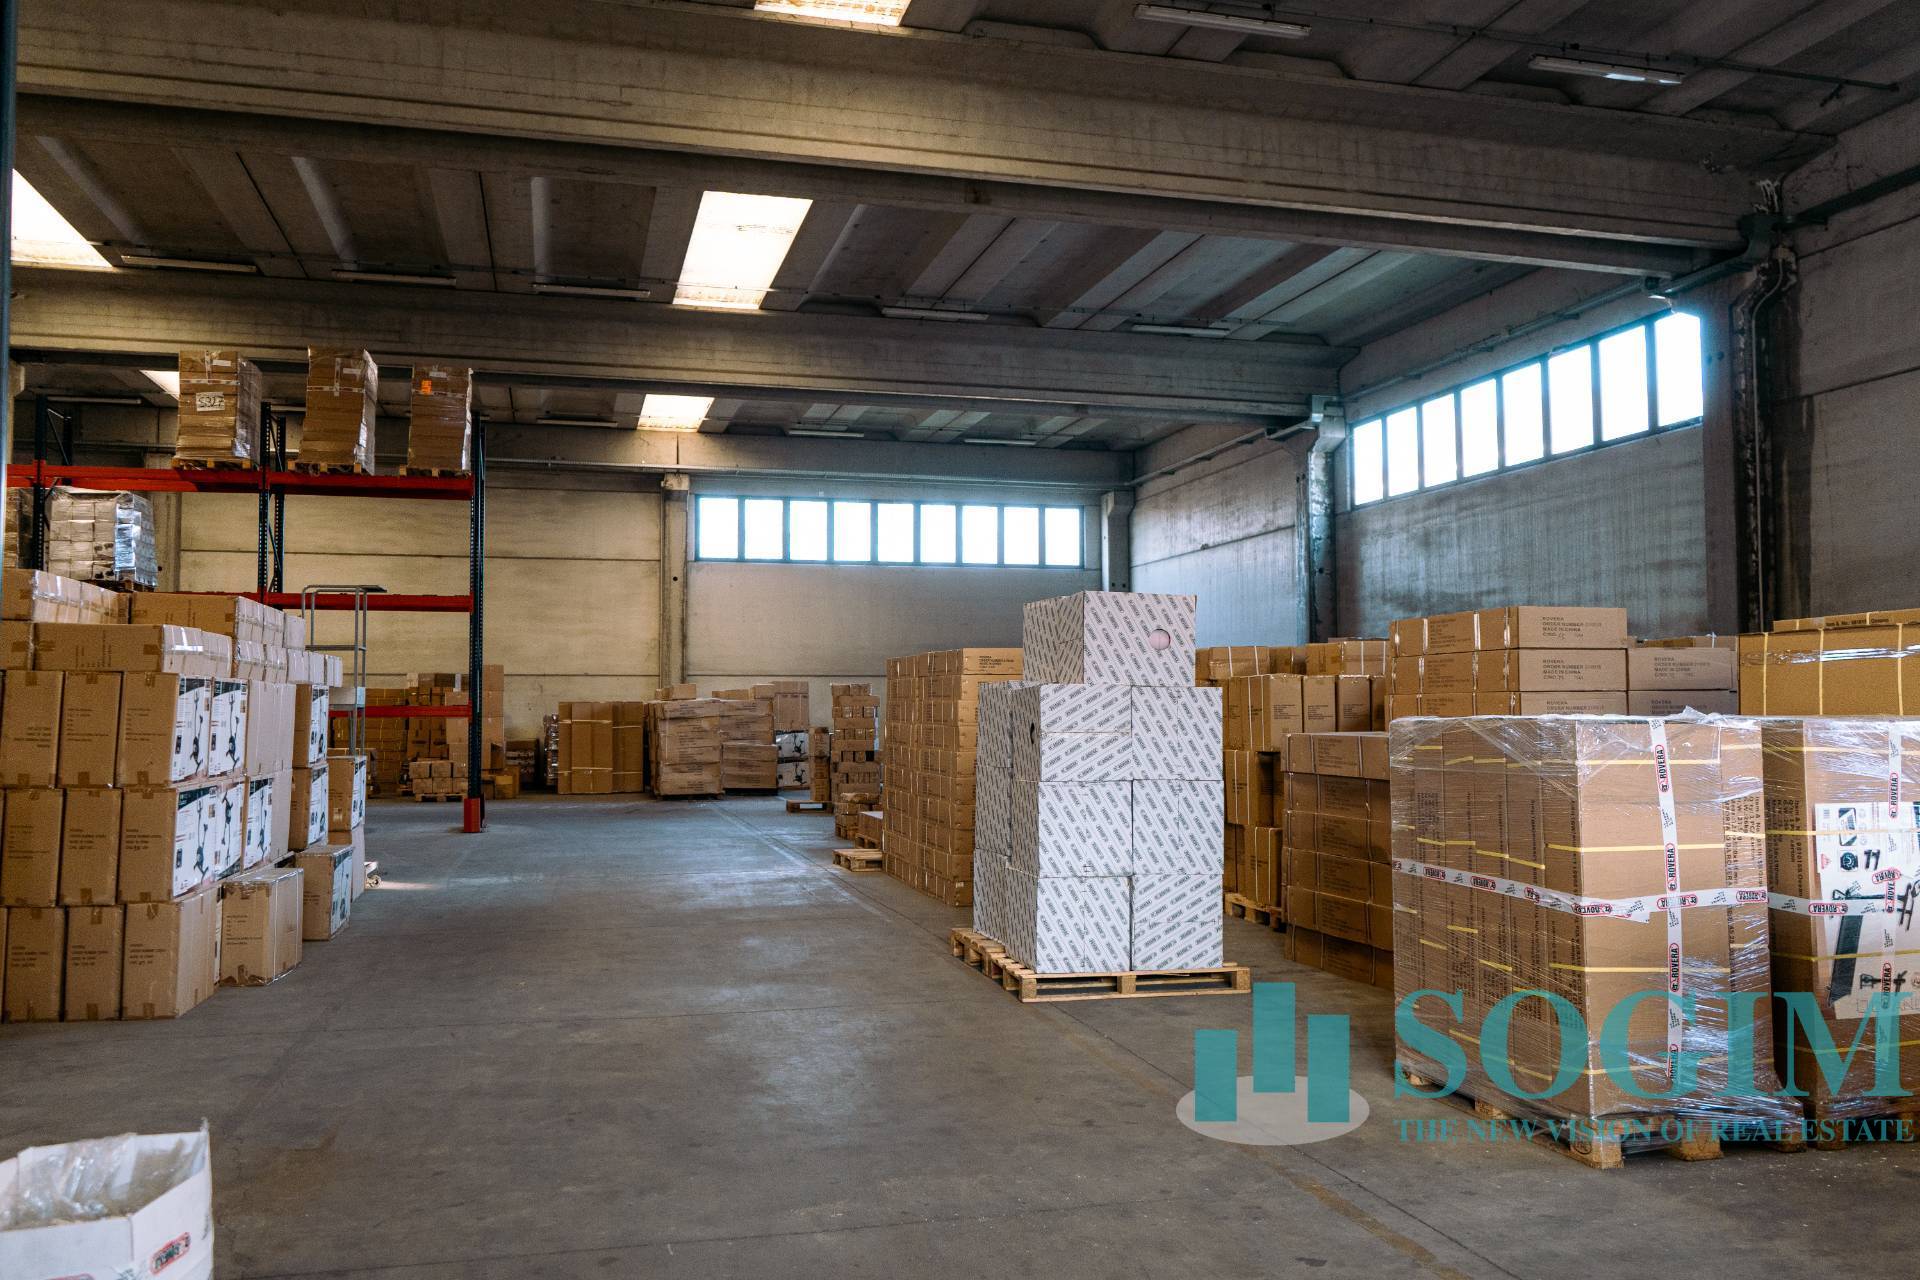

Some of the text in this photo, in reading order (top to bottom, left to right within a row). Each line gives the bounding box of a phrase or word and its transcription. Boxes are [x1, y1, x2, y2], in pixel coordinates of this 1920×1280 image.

[1656, 749, 1667, 779] ROVERA
[1890, 777, 1898, 806] ROVERA
[1667, 848, 1676, 878] ROVERA
[1812, 904, 1837, 913] ROVERA
[1670, 947, 1679, 978] ROVERA
